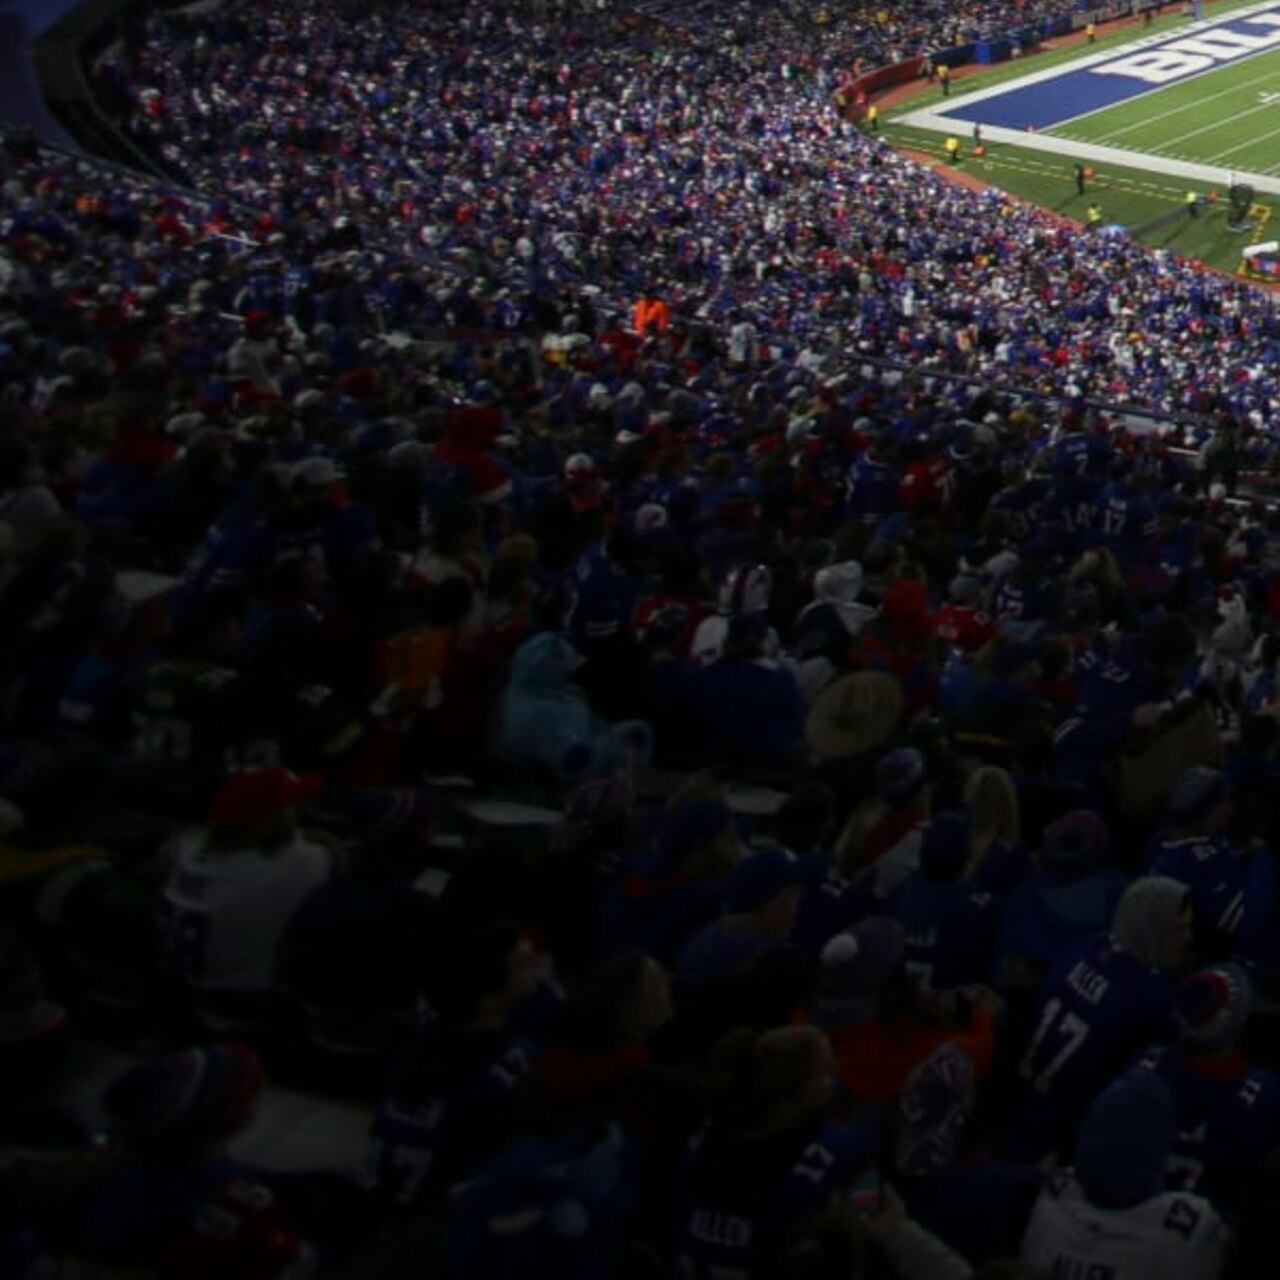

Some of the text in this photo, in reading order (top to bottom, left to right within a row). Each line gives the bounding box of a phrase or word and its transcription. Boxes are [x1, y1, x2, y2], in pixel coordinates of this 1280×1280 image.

[1066, 959, 1110, 1007] ALLEN
[1018, 996, 1092, 1094] 17
[792, 1141, 836, 1184] 17
